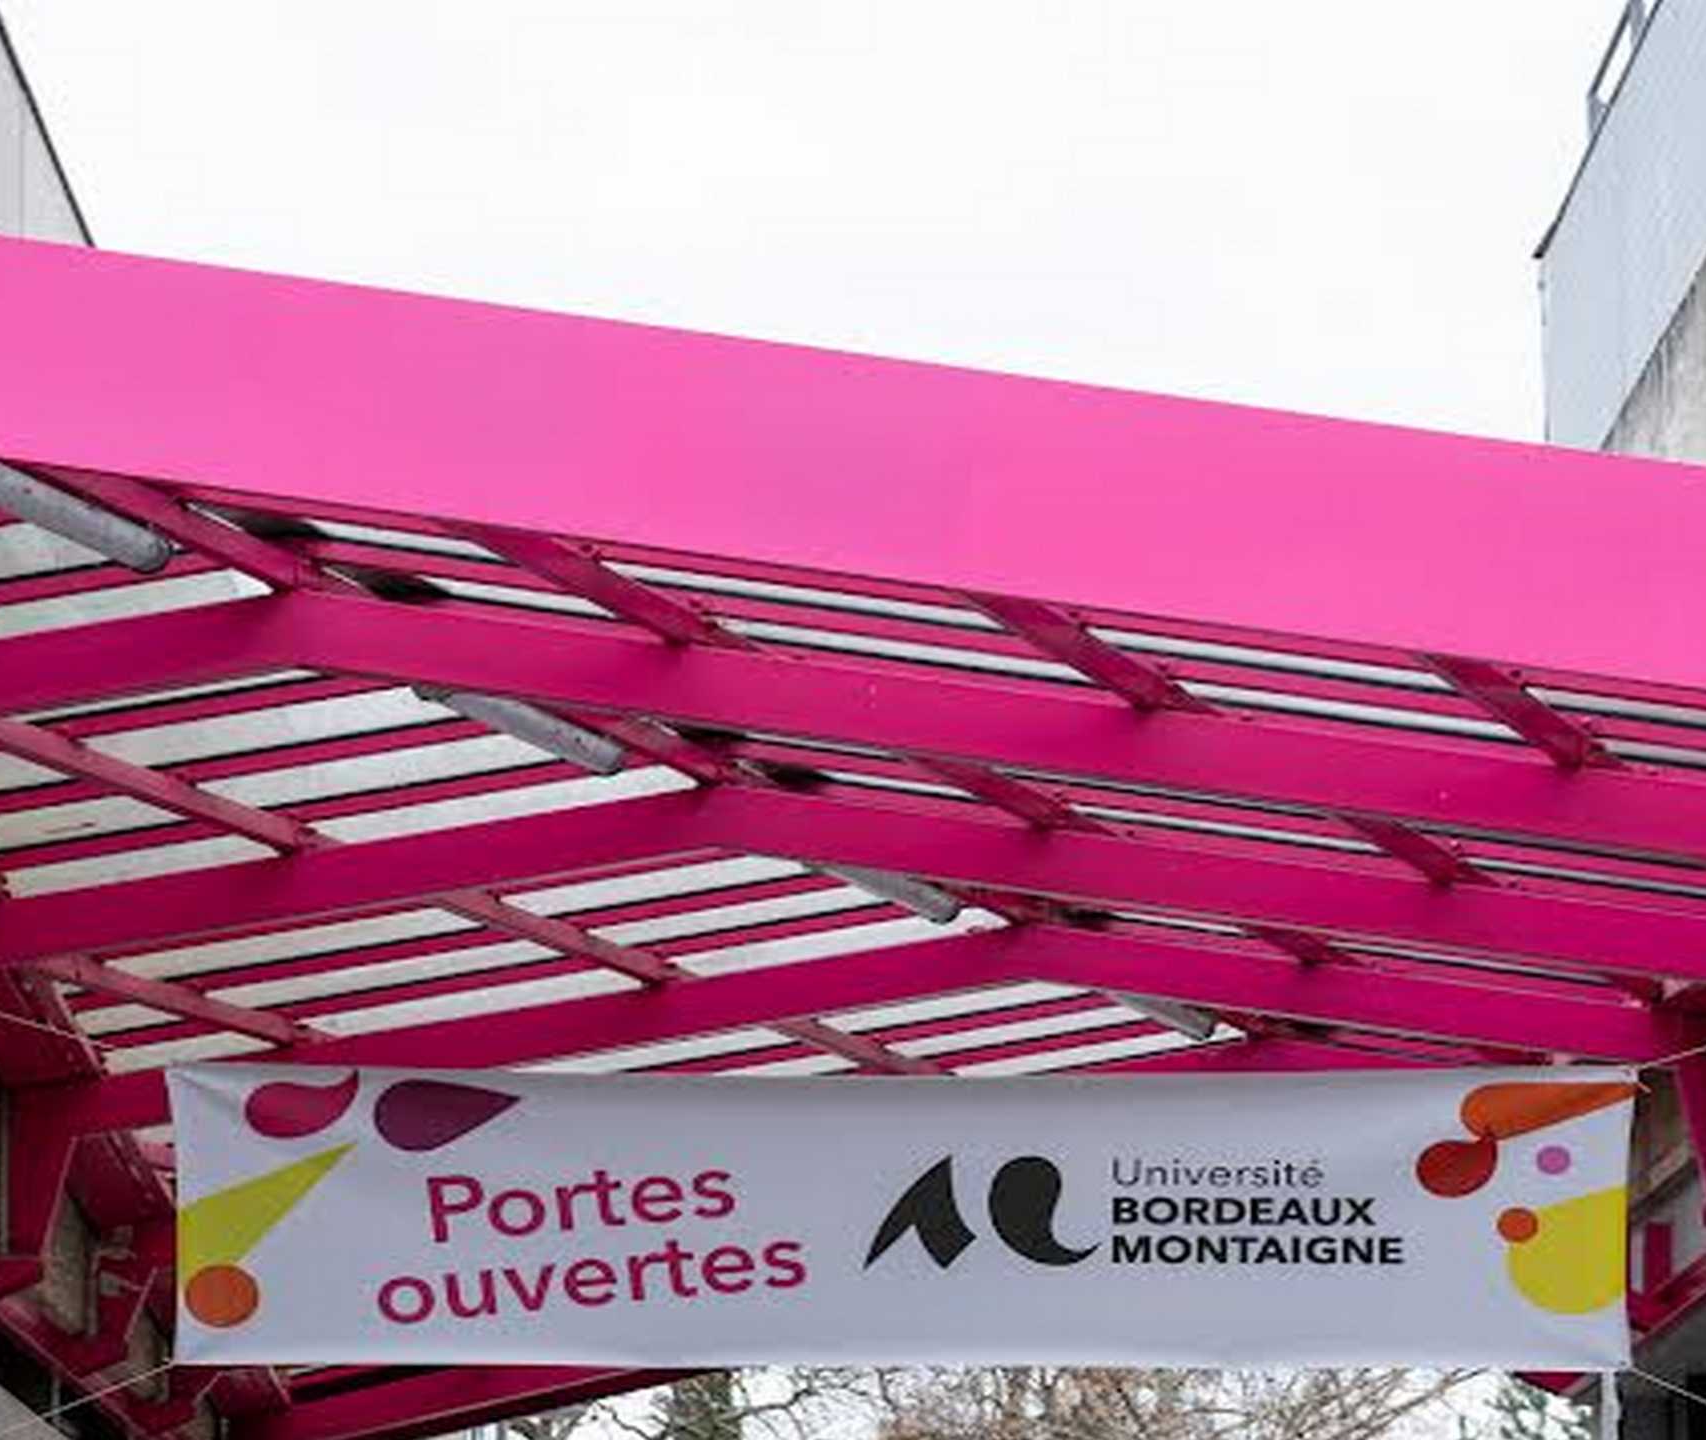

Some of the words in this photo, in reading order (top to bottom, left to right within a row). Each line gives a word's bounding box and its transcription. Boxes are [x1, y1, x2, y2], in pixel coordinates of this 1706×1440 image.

[1111, 1156, 1326, 1188] Université
[425, 1169, 736, 1243] Portes
[1111, 1197, 1376, 1227] BORDEAUX
[1111, 1235, 1405, 1265] MONTAIGNE
[376, 1239, 808, 1325] ouvertes
